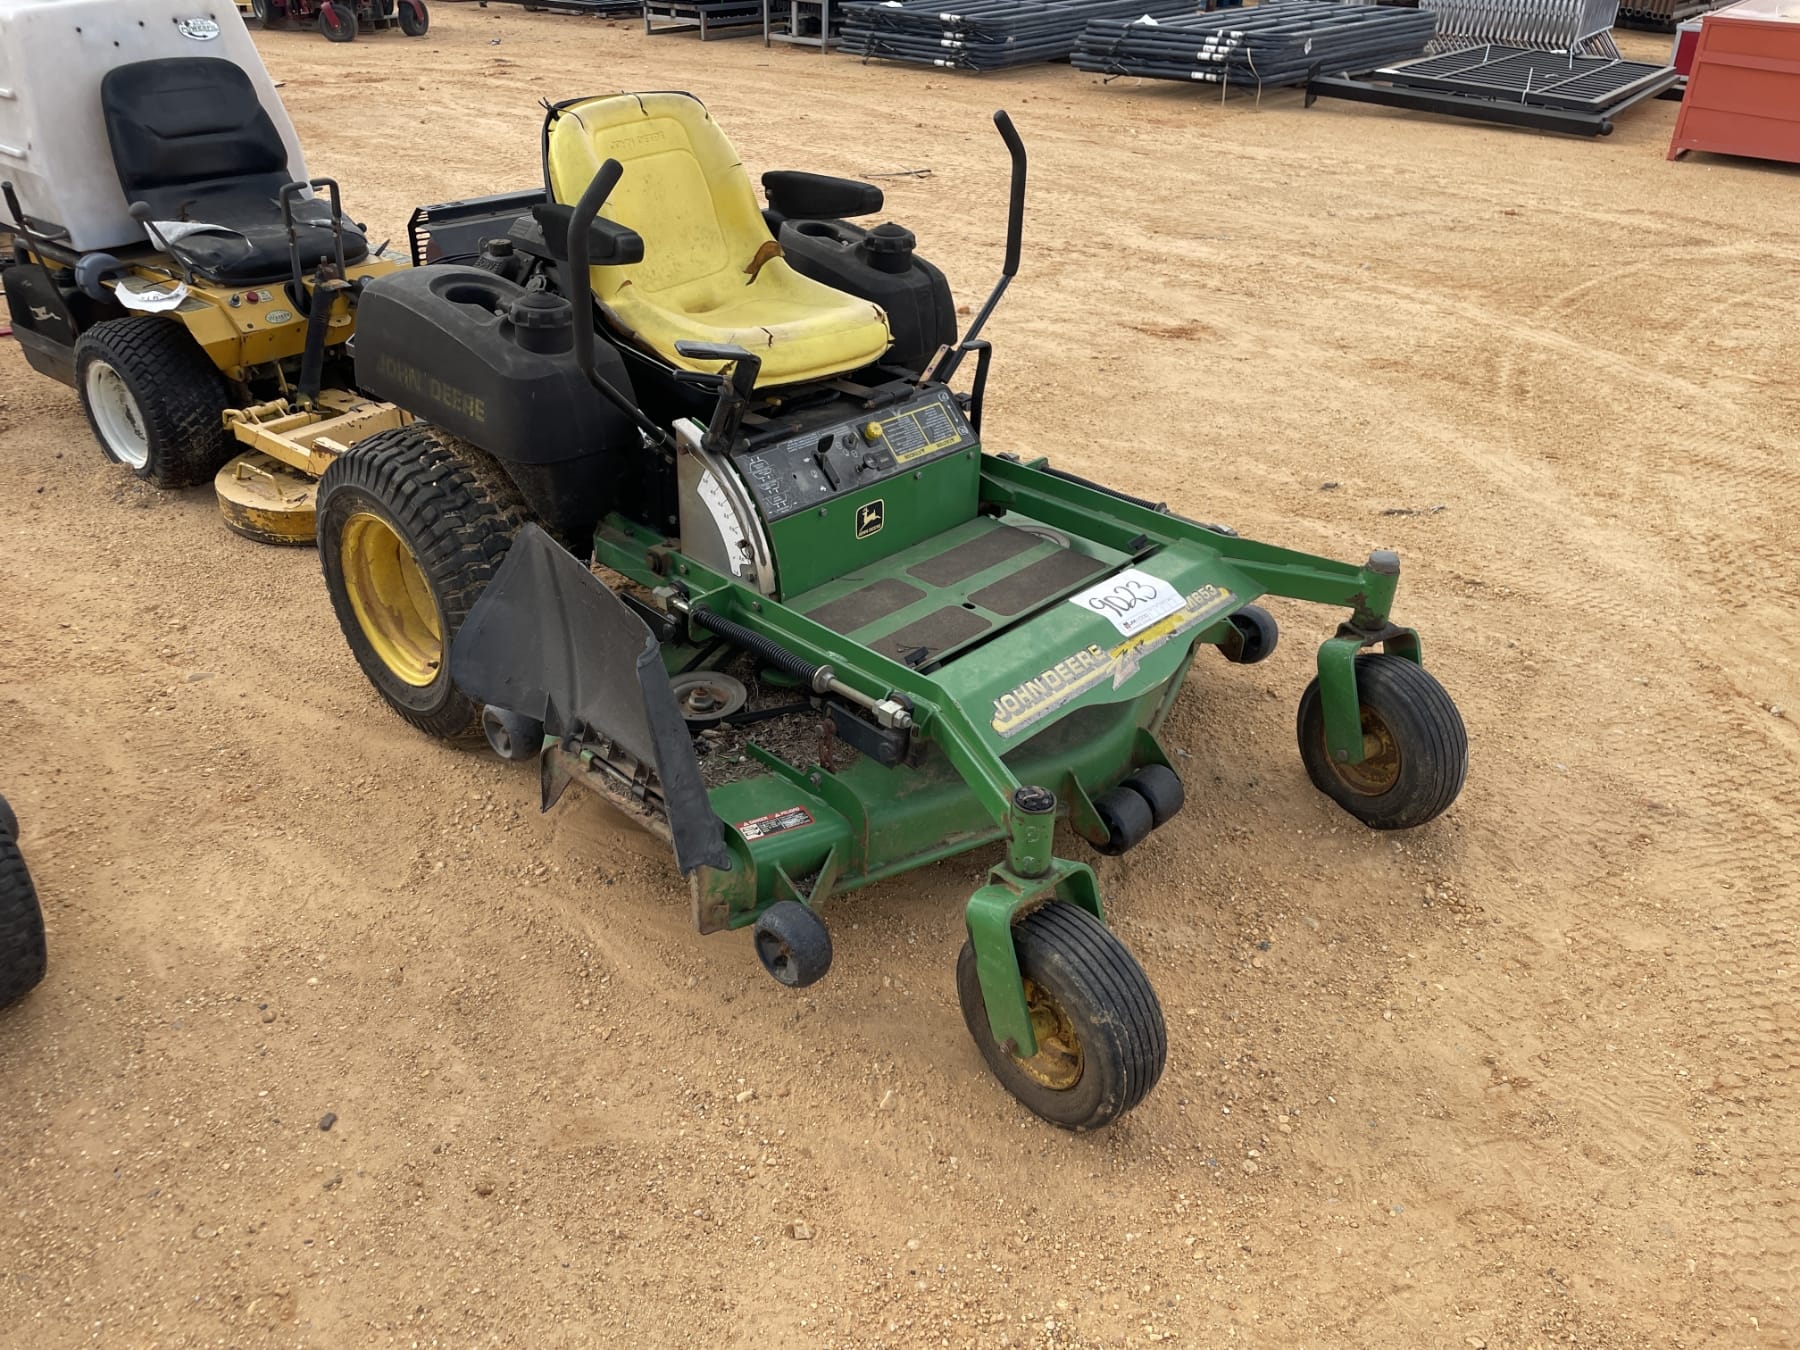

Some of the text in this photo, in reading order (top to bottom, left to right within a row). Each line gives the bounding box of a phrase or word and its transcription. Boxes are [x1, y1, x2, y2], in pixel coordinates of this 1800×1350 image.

[431, 378, 486, 422] DEERE
[1088, 580, 1157, 617] 9023
[993, 678, 1048, 720] JOHN
[1041, 644, 1106, 688] DEERE
